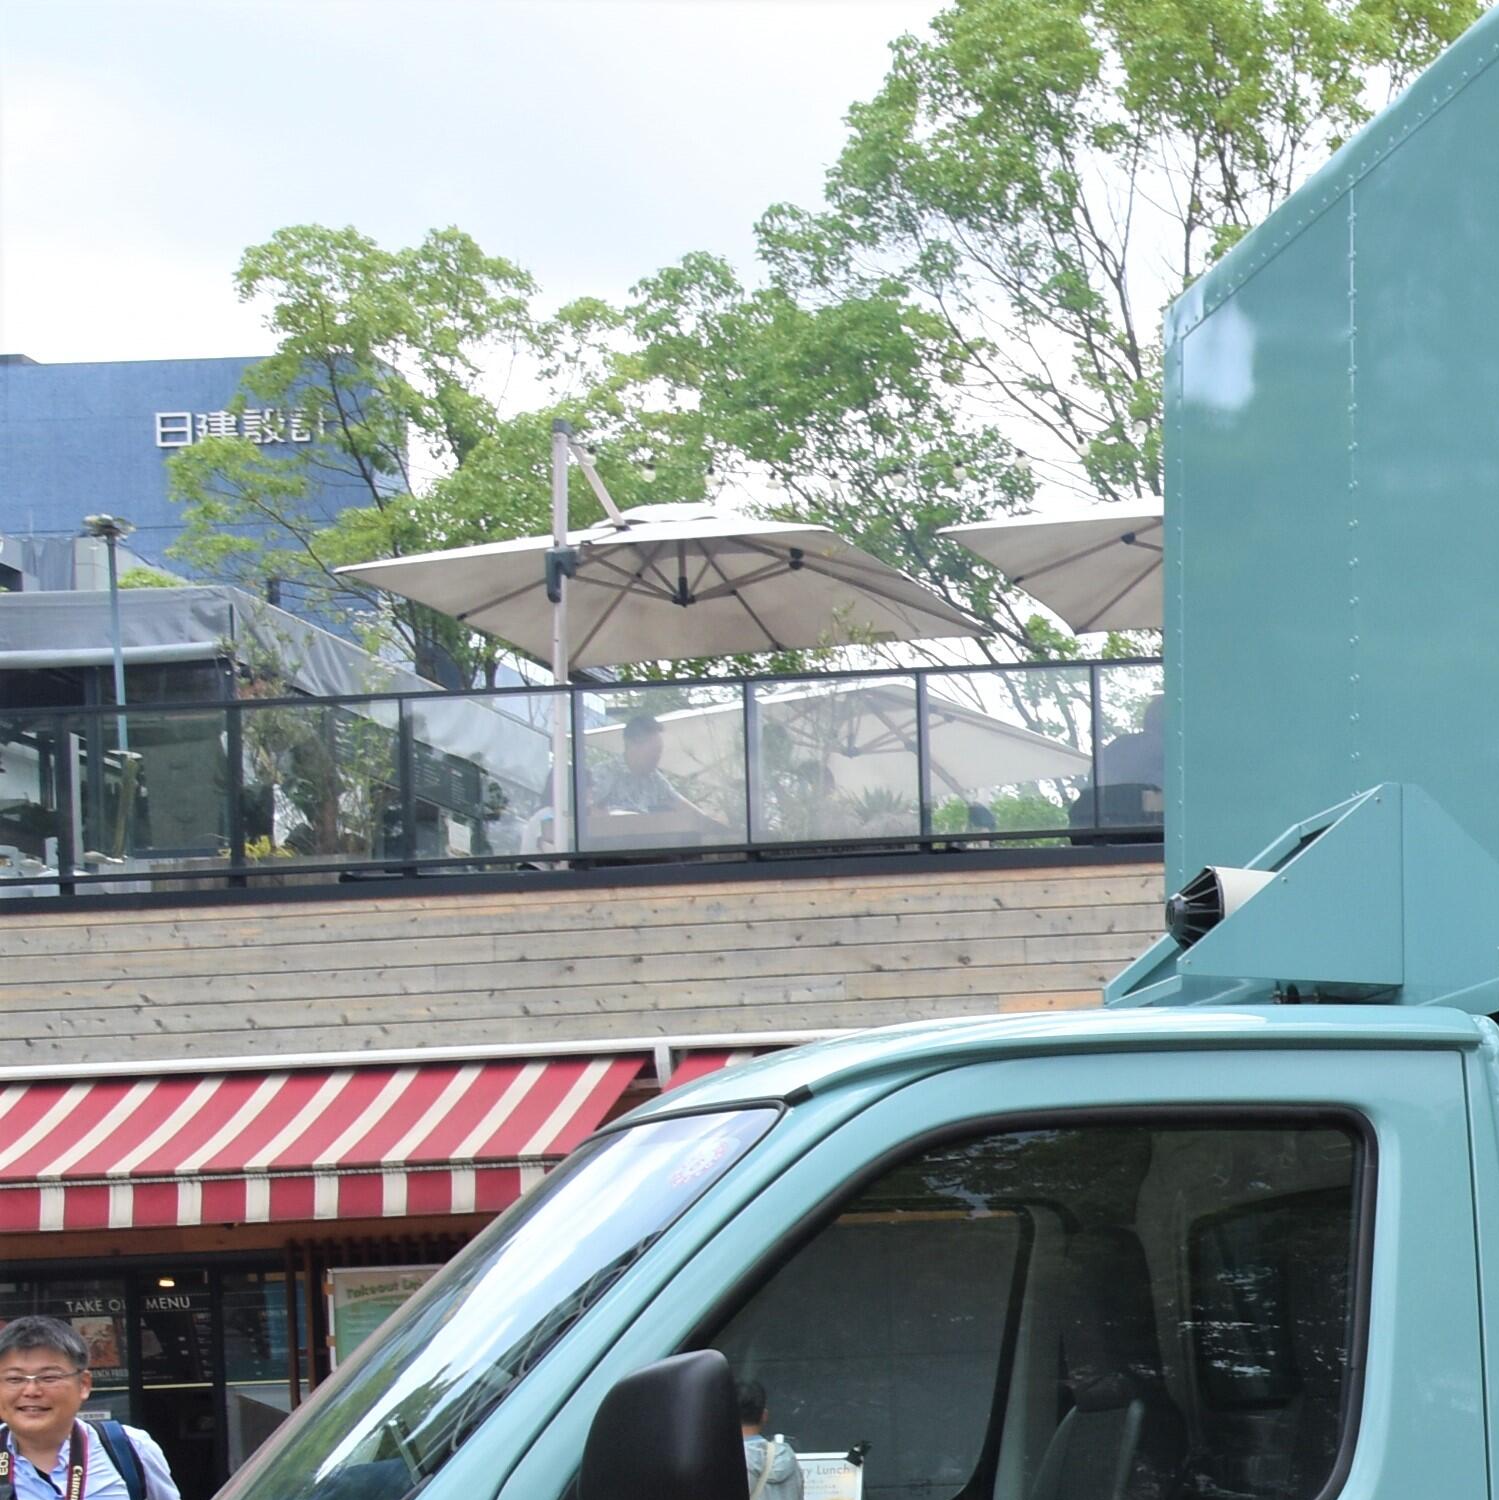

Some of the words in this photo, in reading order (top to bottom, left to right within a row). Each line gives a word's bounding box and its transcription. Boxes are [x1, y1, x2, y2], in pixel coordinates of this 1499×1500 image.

[66, 1299, 104, 1313] TAKE
[146, 1296, 191, 1310] MENU
[0, 1452, 9, 1477] EOS
[816, 1464, 850, 1476] Lunch
